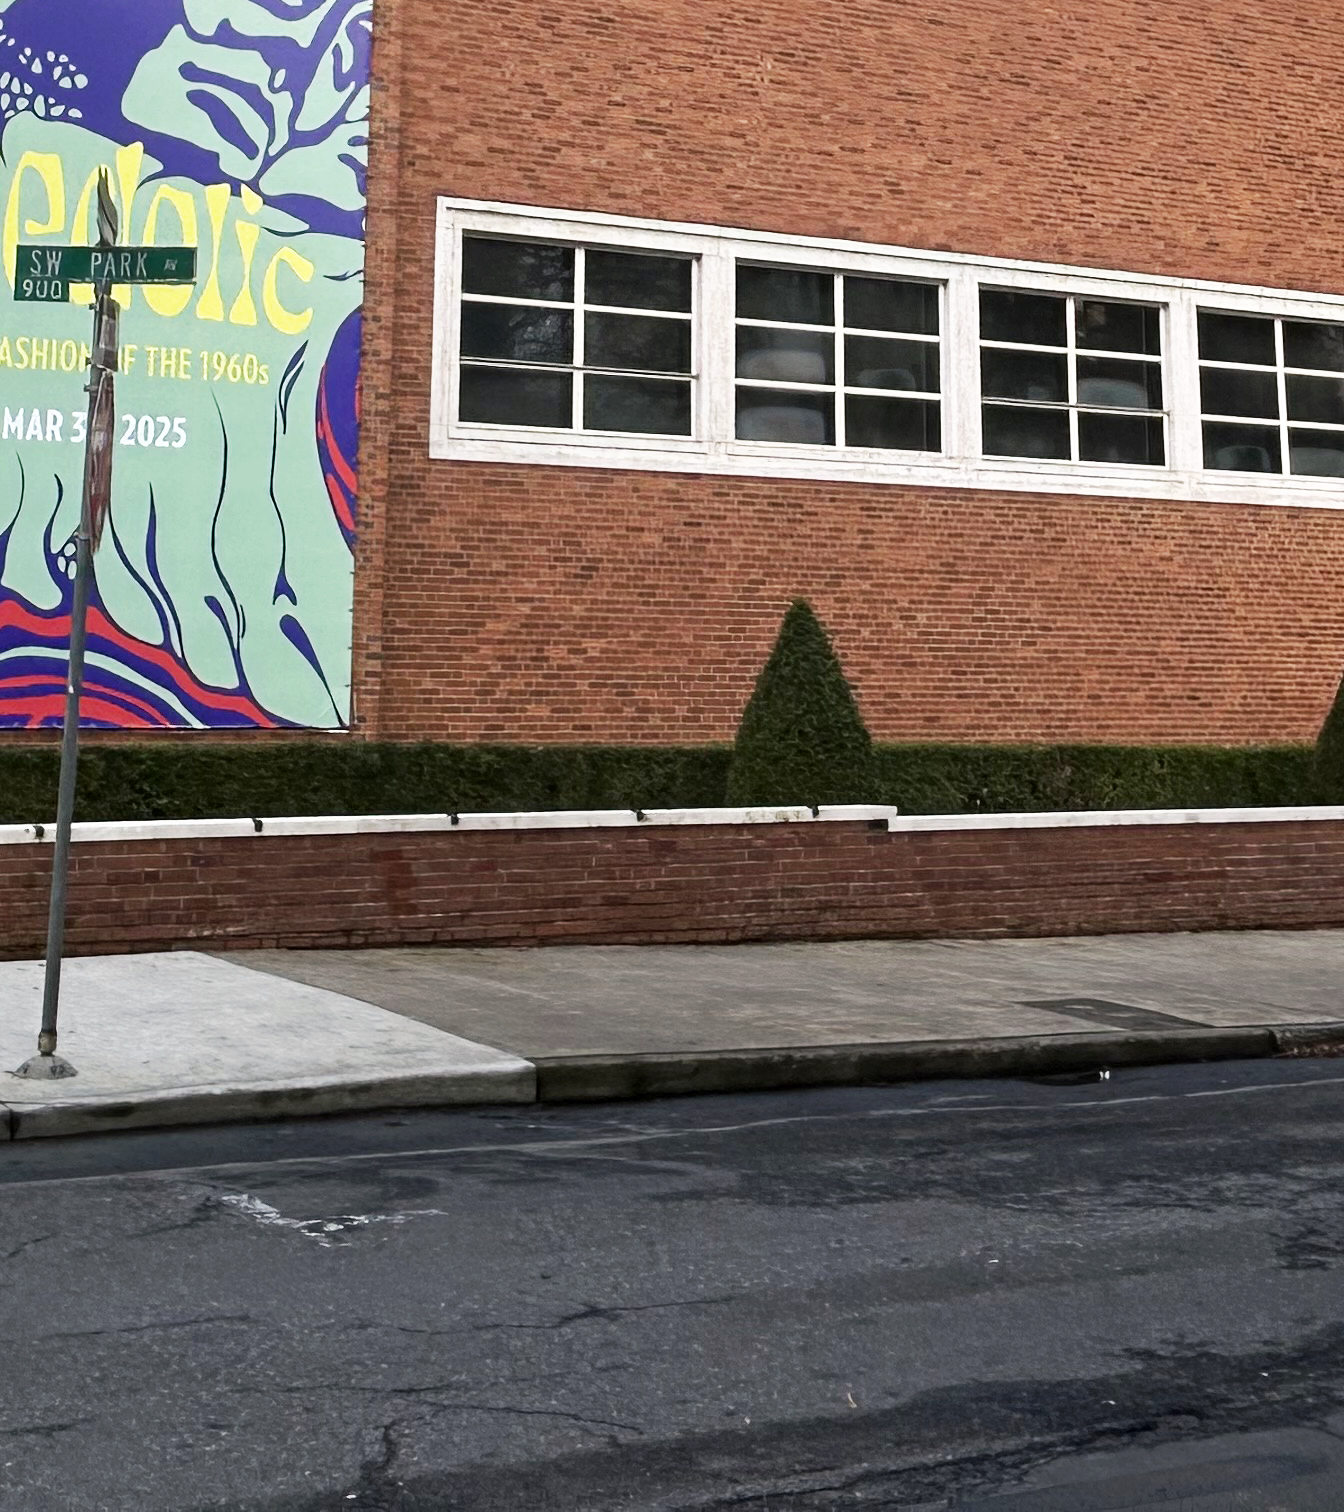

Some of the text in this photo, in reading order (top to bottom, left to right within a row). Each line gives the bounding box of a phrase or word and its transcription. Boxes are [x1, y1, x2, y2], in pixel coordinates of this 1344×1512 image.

[30, 249, 62, 277] SW
[91, 252, 148, 278] PARK
[22, 279, 62, 300] 900
[146, 345, 193, 380] THE
[199, 351, 270, 385] 1960s
[1, 406, 64, 442] MAR
[119, 413, 188, 448] 2025
